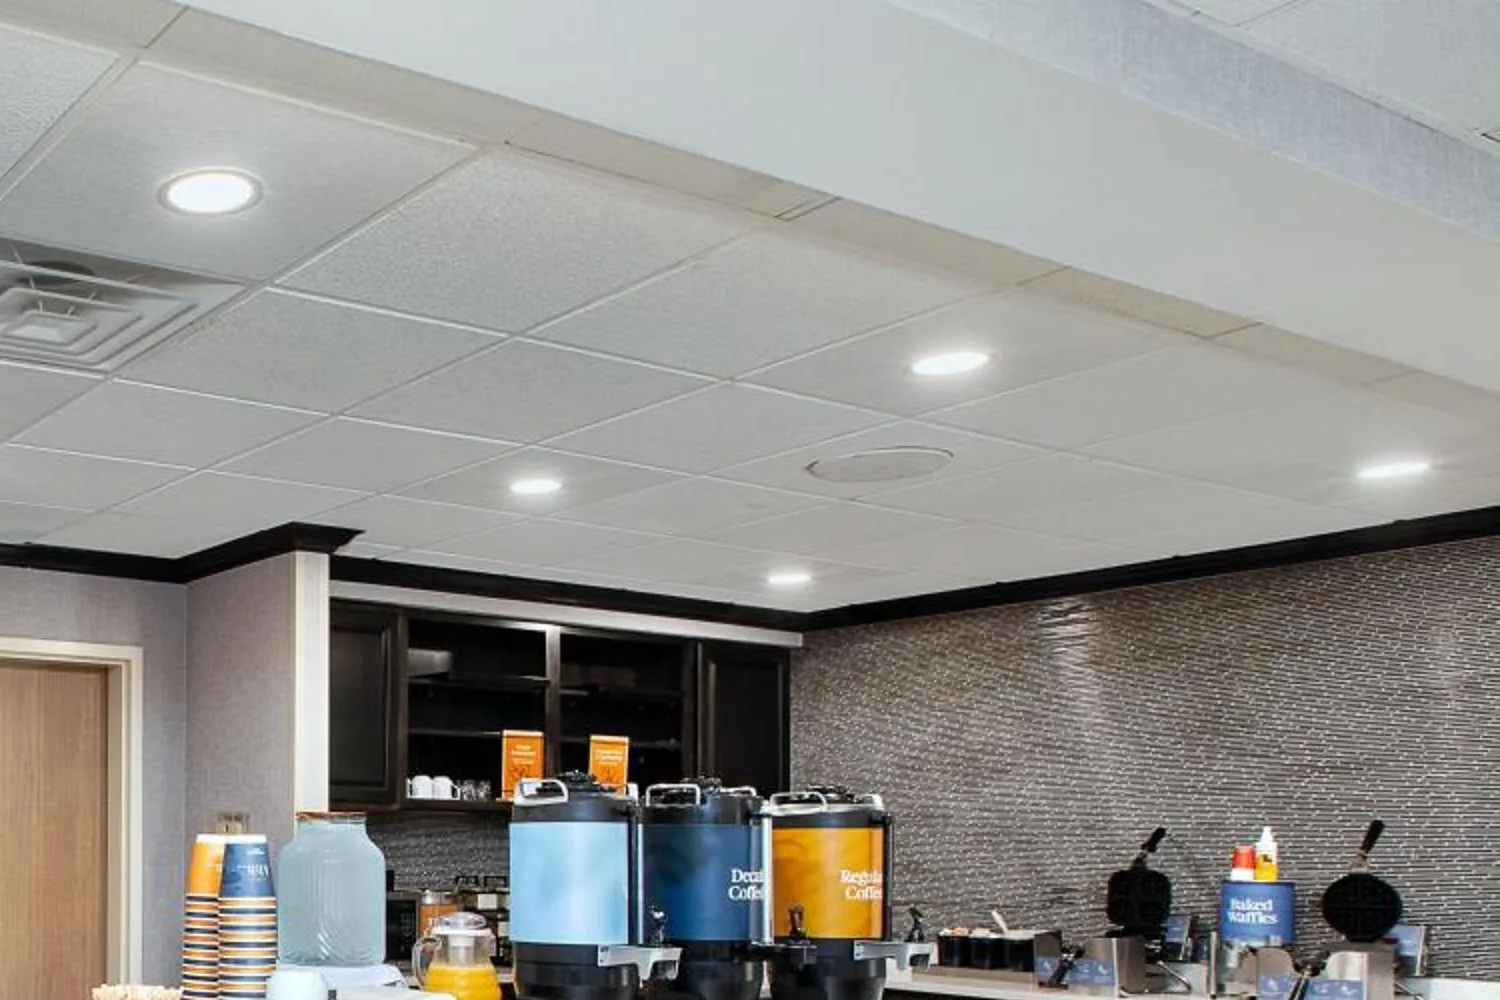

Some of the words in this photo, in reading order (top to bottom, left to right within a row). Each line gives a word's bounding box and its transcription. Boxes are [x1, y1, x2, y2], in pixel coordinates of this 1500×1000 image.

[731, 869, 764, 883] Deca
[840, 869, 882, 887] Regula
[728, 885, 765, 900] Coffe
[844, 886, 882, 900] Coffe
[1230, 897, 1273, 911] Baked
[1227, 911, 1279, 925] Waffles
